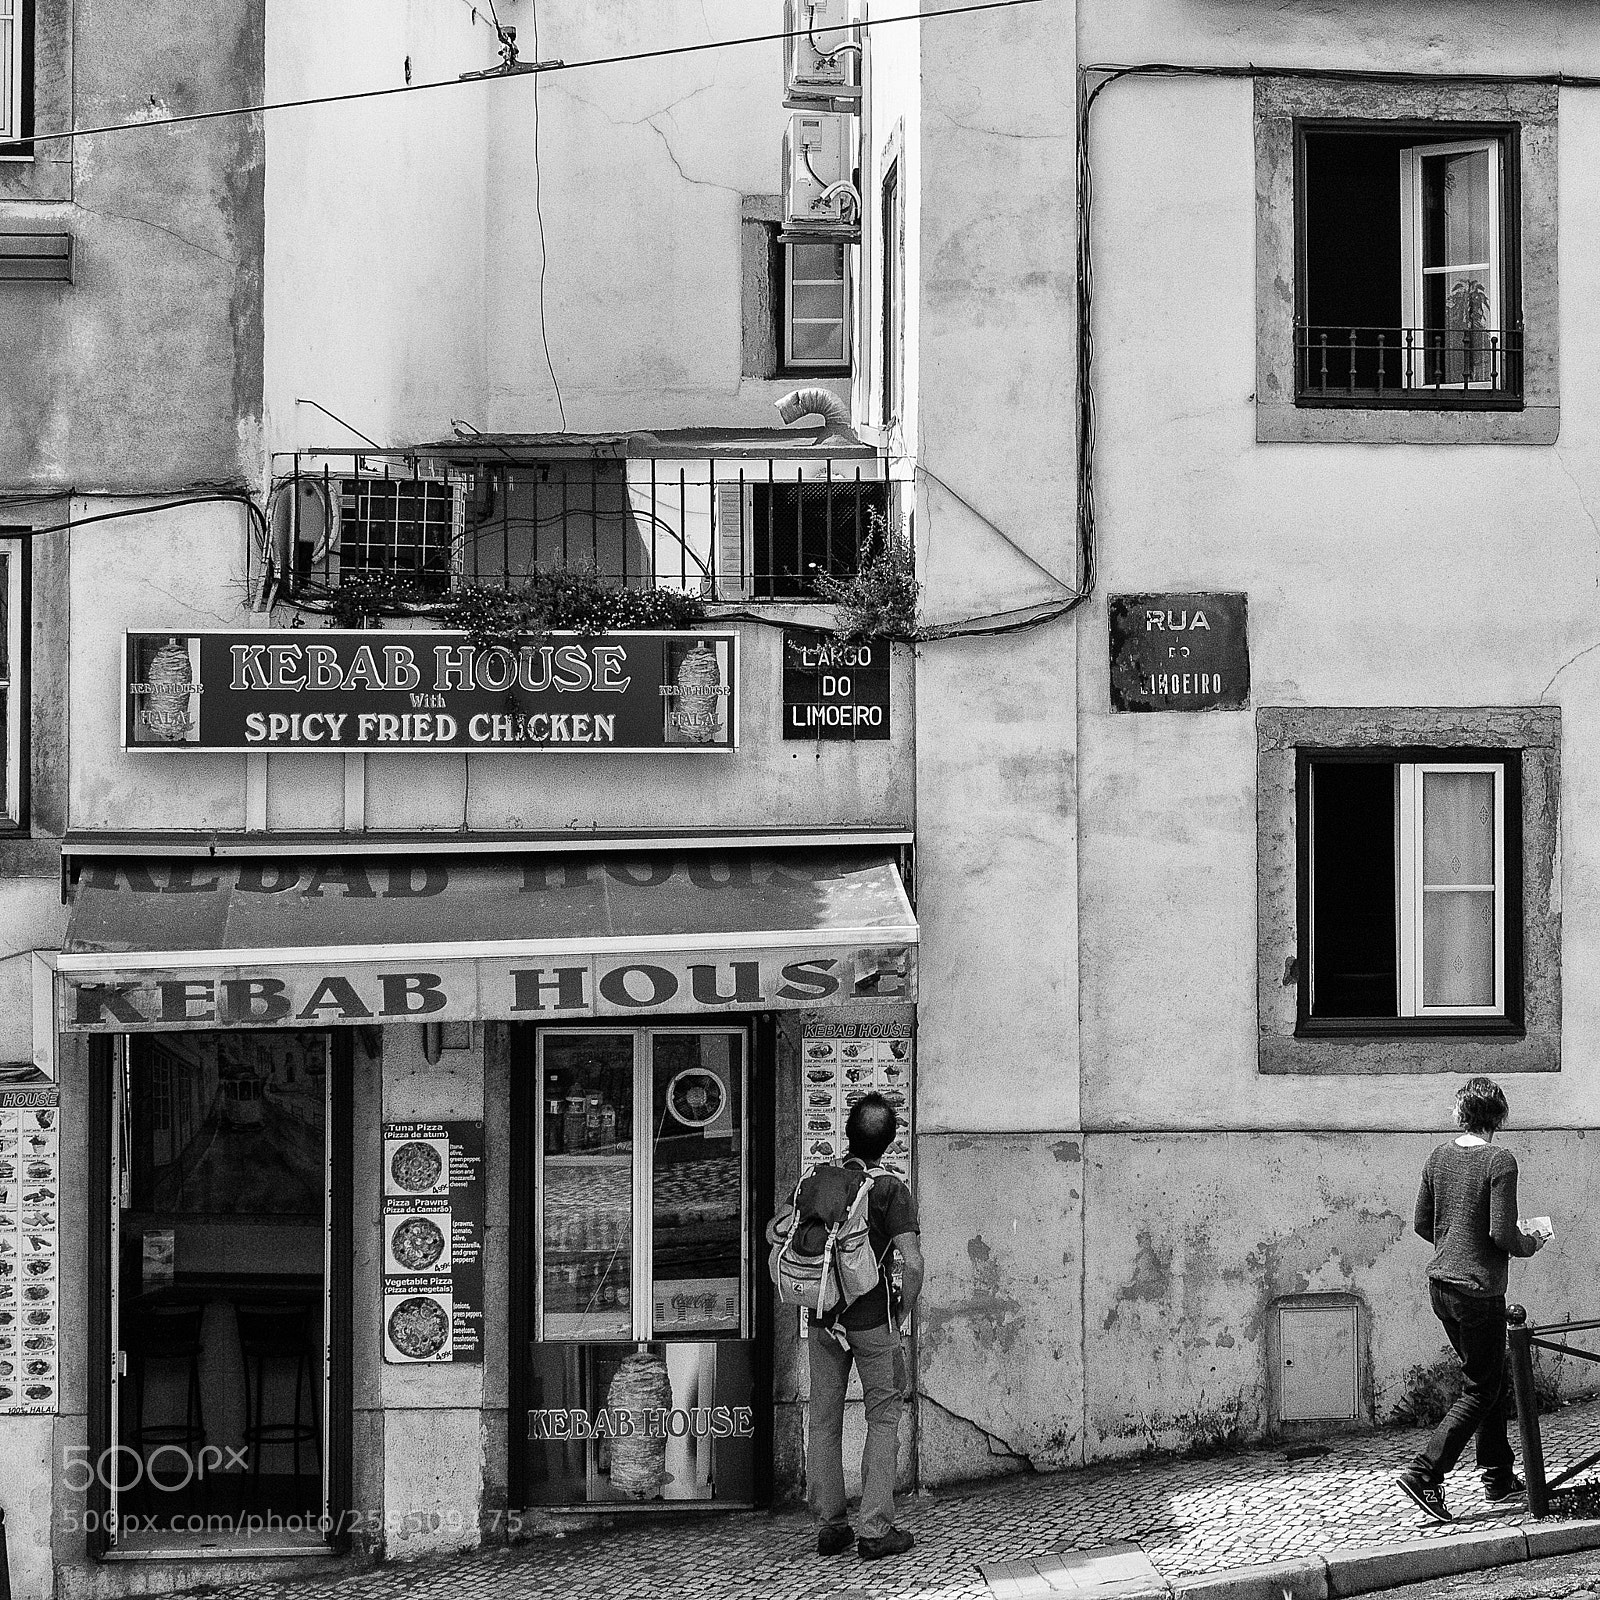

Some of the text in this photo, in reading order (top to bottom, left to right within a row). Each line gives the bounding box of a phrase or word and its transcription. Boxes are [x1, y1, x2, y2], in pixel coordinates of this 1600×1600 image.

[1146, 610, 1211, 631] RUA
[802, 646, 872, 666] LARGO
[229, 643, 631, 693] KEBAB HOUSE
[130, 683, 205, 694] KEBAB HOUSE
[658, 685, 731, 696] KEBAB HOUSE
[822, 675, 851, 696] DO
[409, 692, 447, 708] With
[141, 710, 195, 725] HALAL
[669, 711, 724, 726] HALAL
[792, 705, 882, 726] LIMOEIRO
[244, 712, 616, 742] SPICY FRIED CHICKEN
[71, 972, 448, 1025] KEBAB
[804, 1023, 912, 1038] KEBAB HOUSE
[3, 1092, 59, 1107] HOUSE
[416, 1123, 443, 1131] Pizza
[383, 1131, 409, 1139] (Pizza
[416, 1205, 452, 1213] Camarão)
[385, 1277, 453, 1287] Vegetable Pizza
[419, 1285, 453, 1293] vegetais)
[528, 1406, 755, 1440] KEBAB HOUSE
